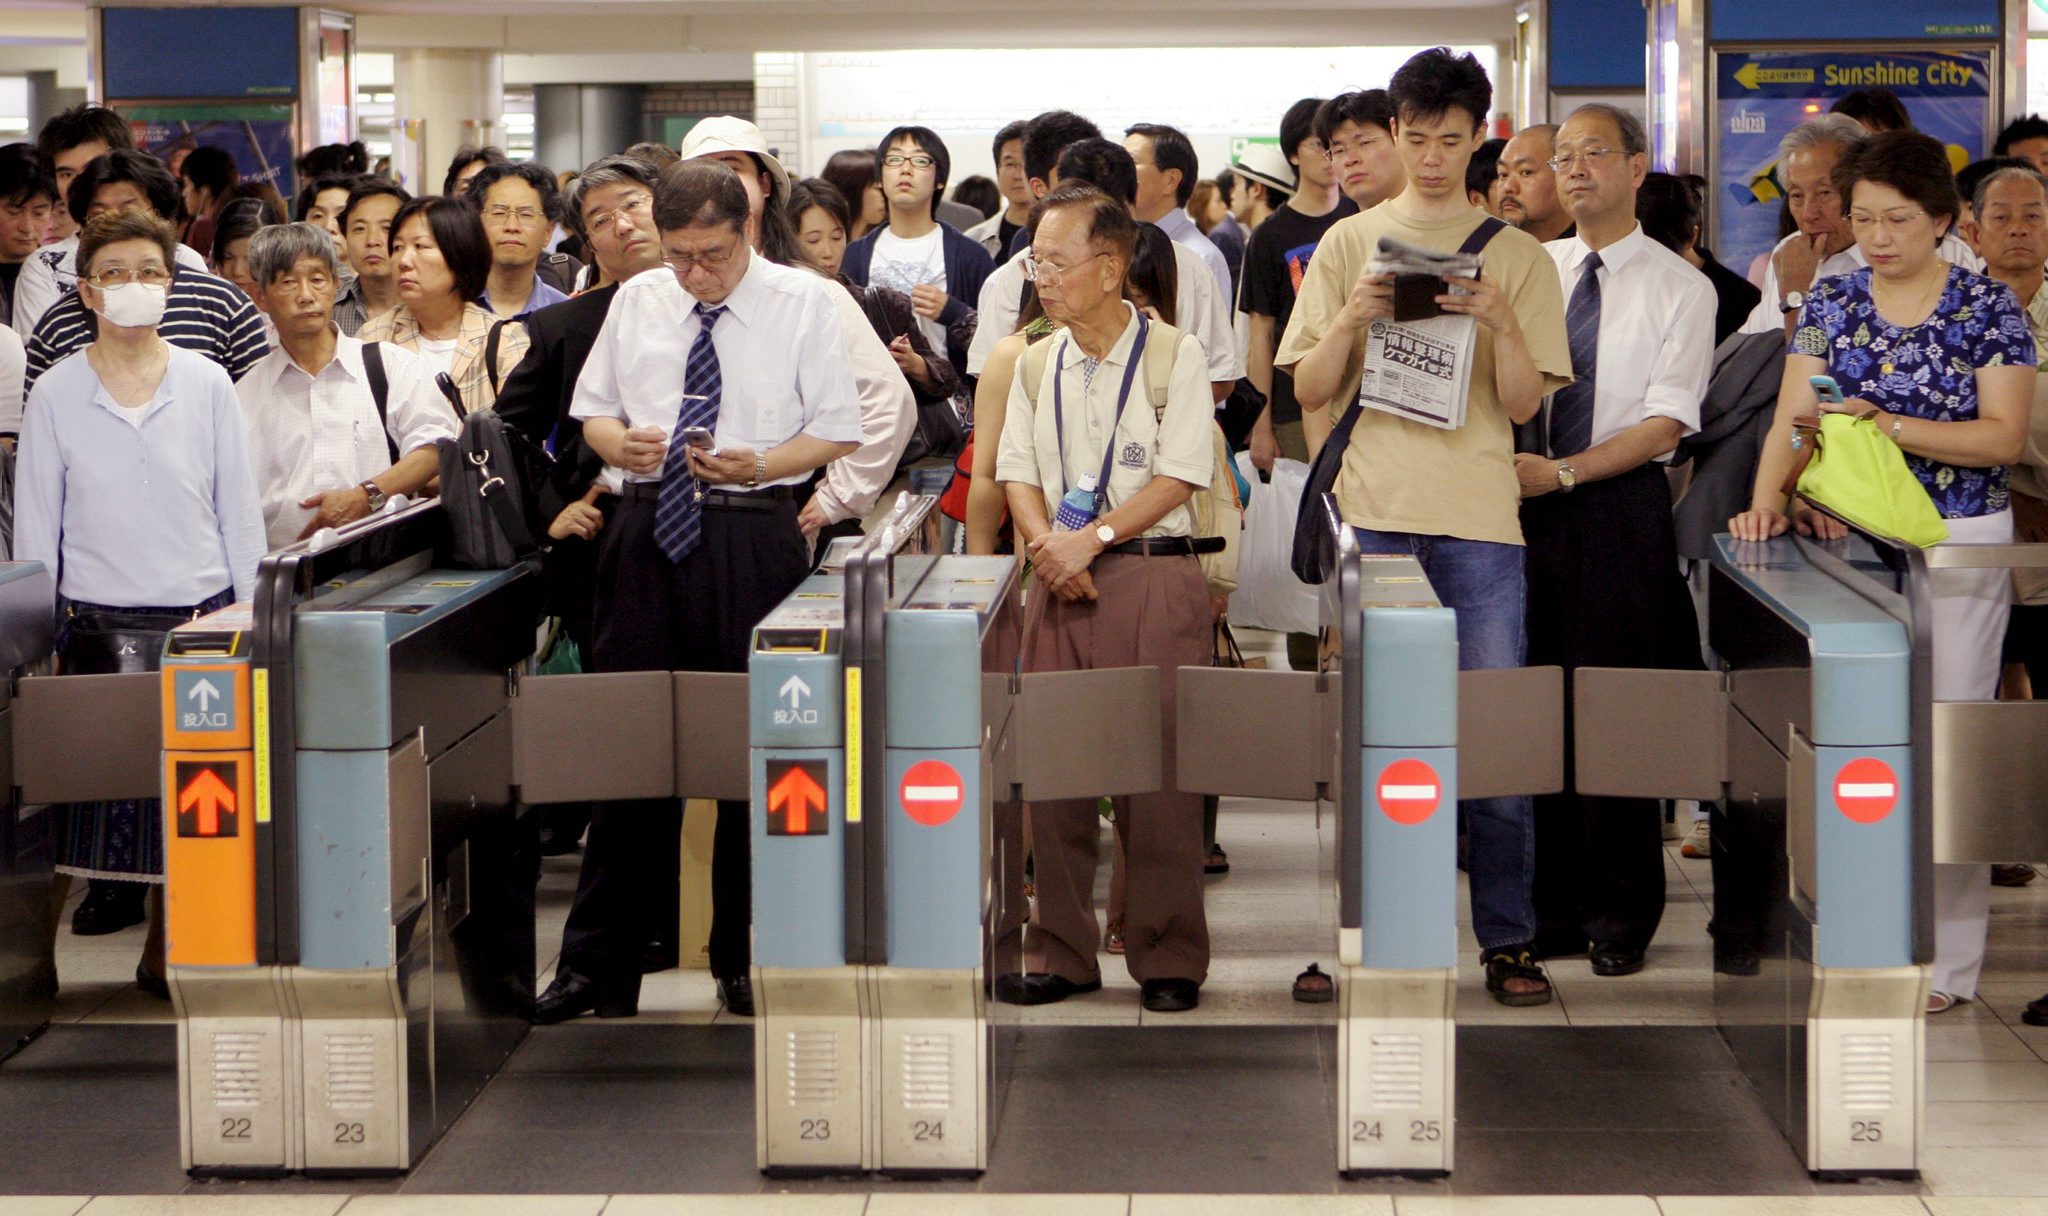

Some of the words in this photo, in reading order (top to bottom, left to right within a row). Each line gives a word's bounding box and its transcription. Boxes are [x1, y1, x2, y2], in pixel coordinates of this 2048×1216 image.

[1825, 61, 1919, 86] Sunshine
[1926, 61, 1973, 87] City
[1386, 332, 1455, 366] 情報整理術
[183, 712, 227, 727] 投入口
[774, 709, 818, 724] 投入口
[222, 1117, 251, 1138] 22
[335, 1122, 365, 1143] 23
[800, 1119, 831, 1140] 23
[914, 1120, 944, 1141] 24
[1353, 1120, 1384, 1141] 24
[1410, 1120, 1441, 1141] 25
[1850, 1121, 1882, 1142] 25
